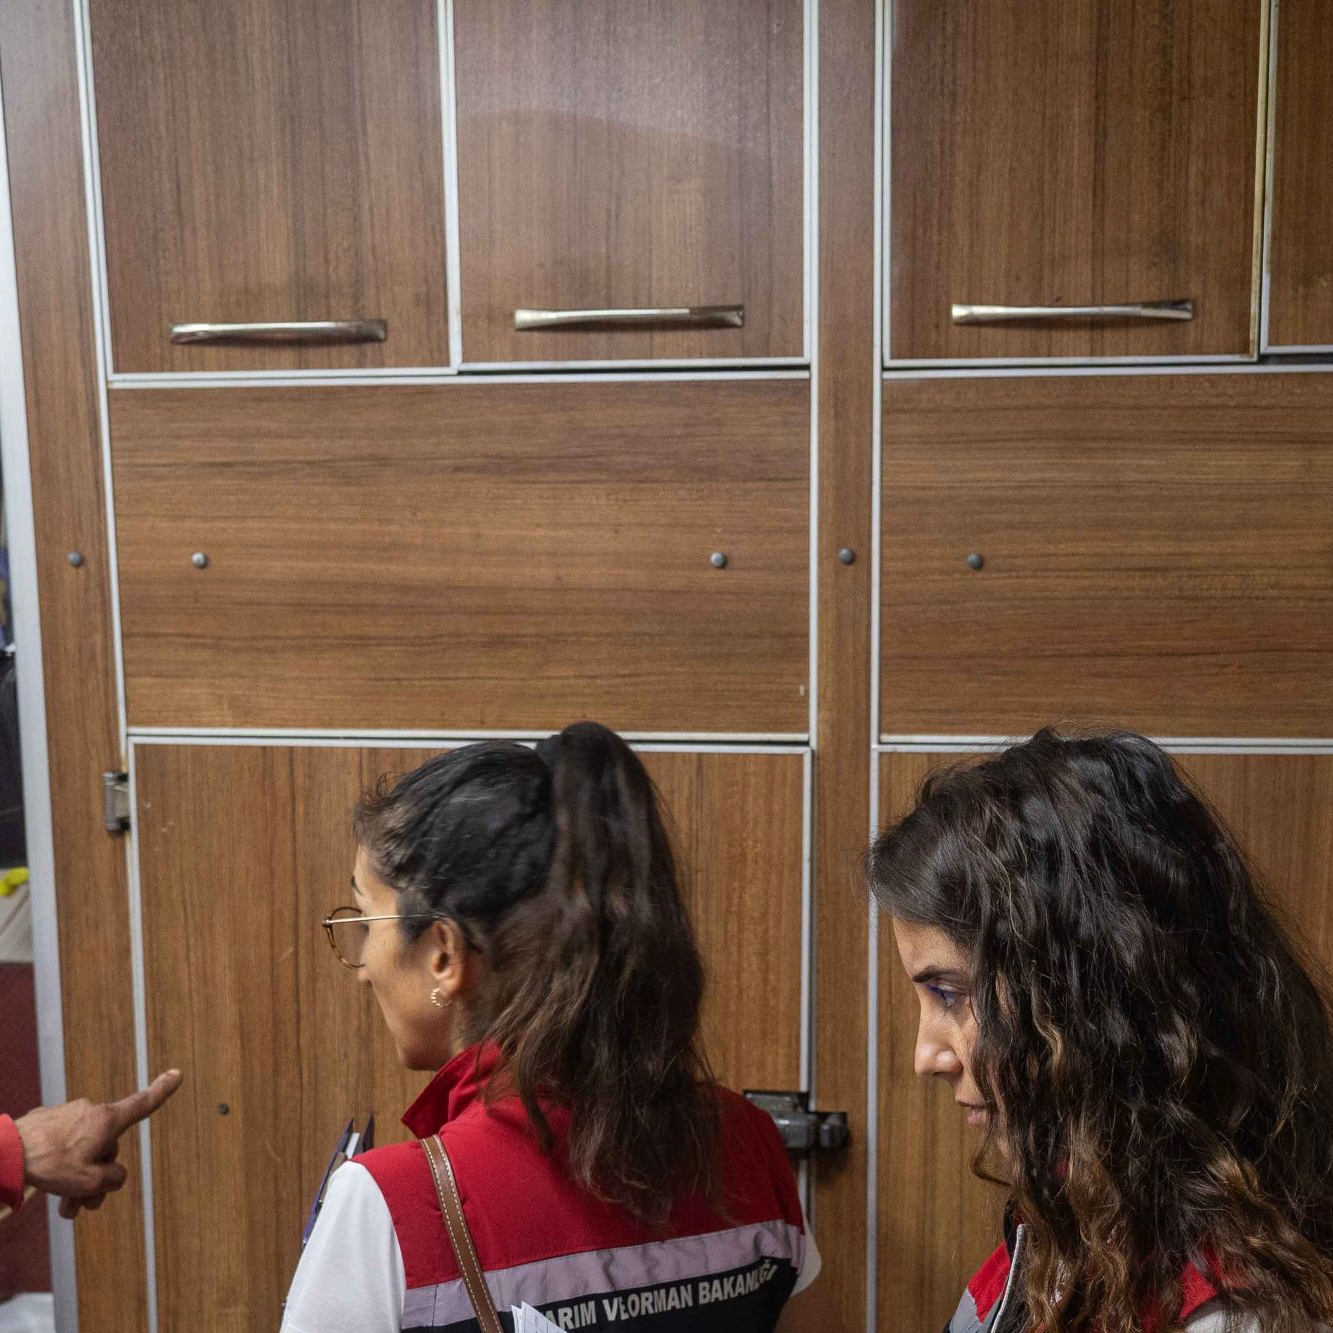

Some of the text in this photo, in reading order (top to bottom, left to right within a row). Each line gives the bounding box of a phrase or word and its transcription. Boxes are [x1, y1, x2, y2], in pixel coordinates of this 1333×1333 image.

[544, 1301, 597, 1331] ARIM
[627, 1284, 693, 1318] ORMAN
[698, 1260, 778, 1305] BAKANLĞI
